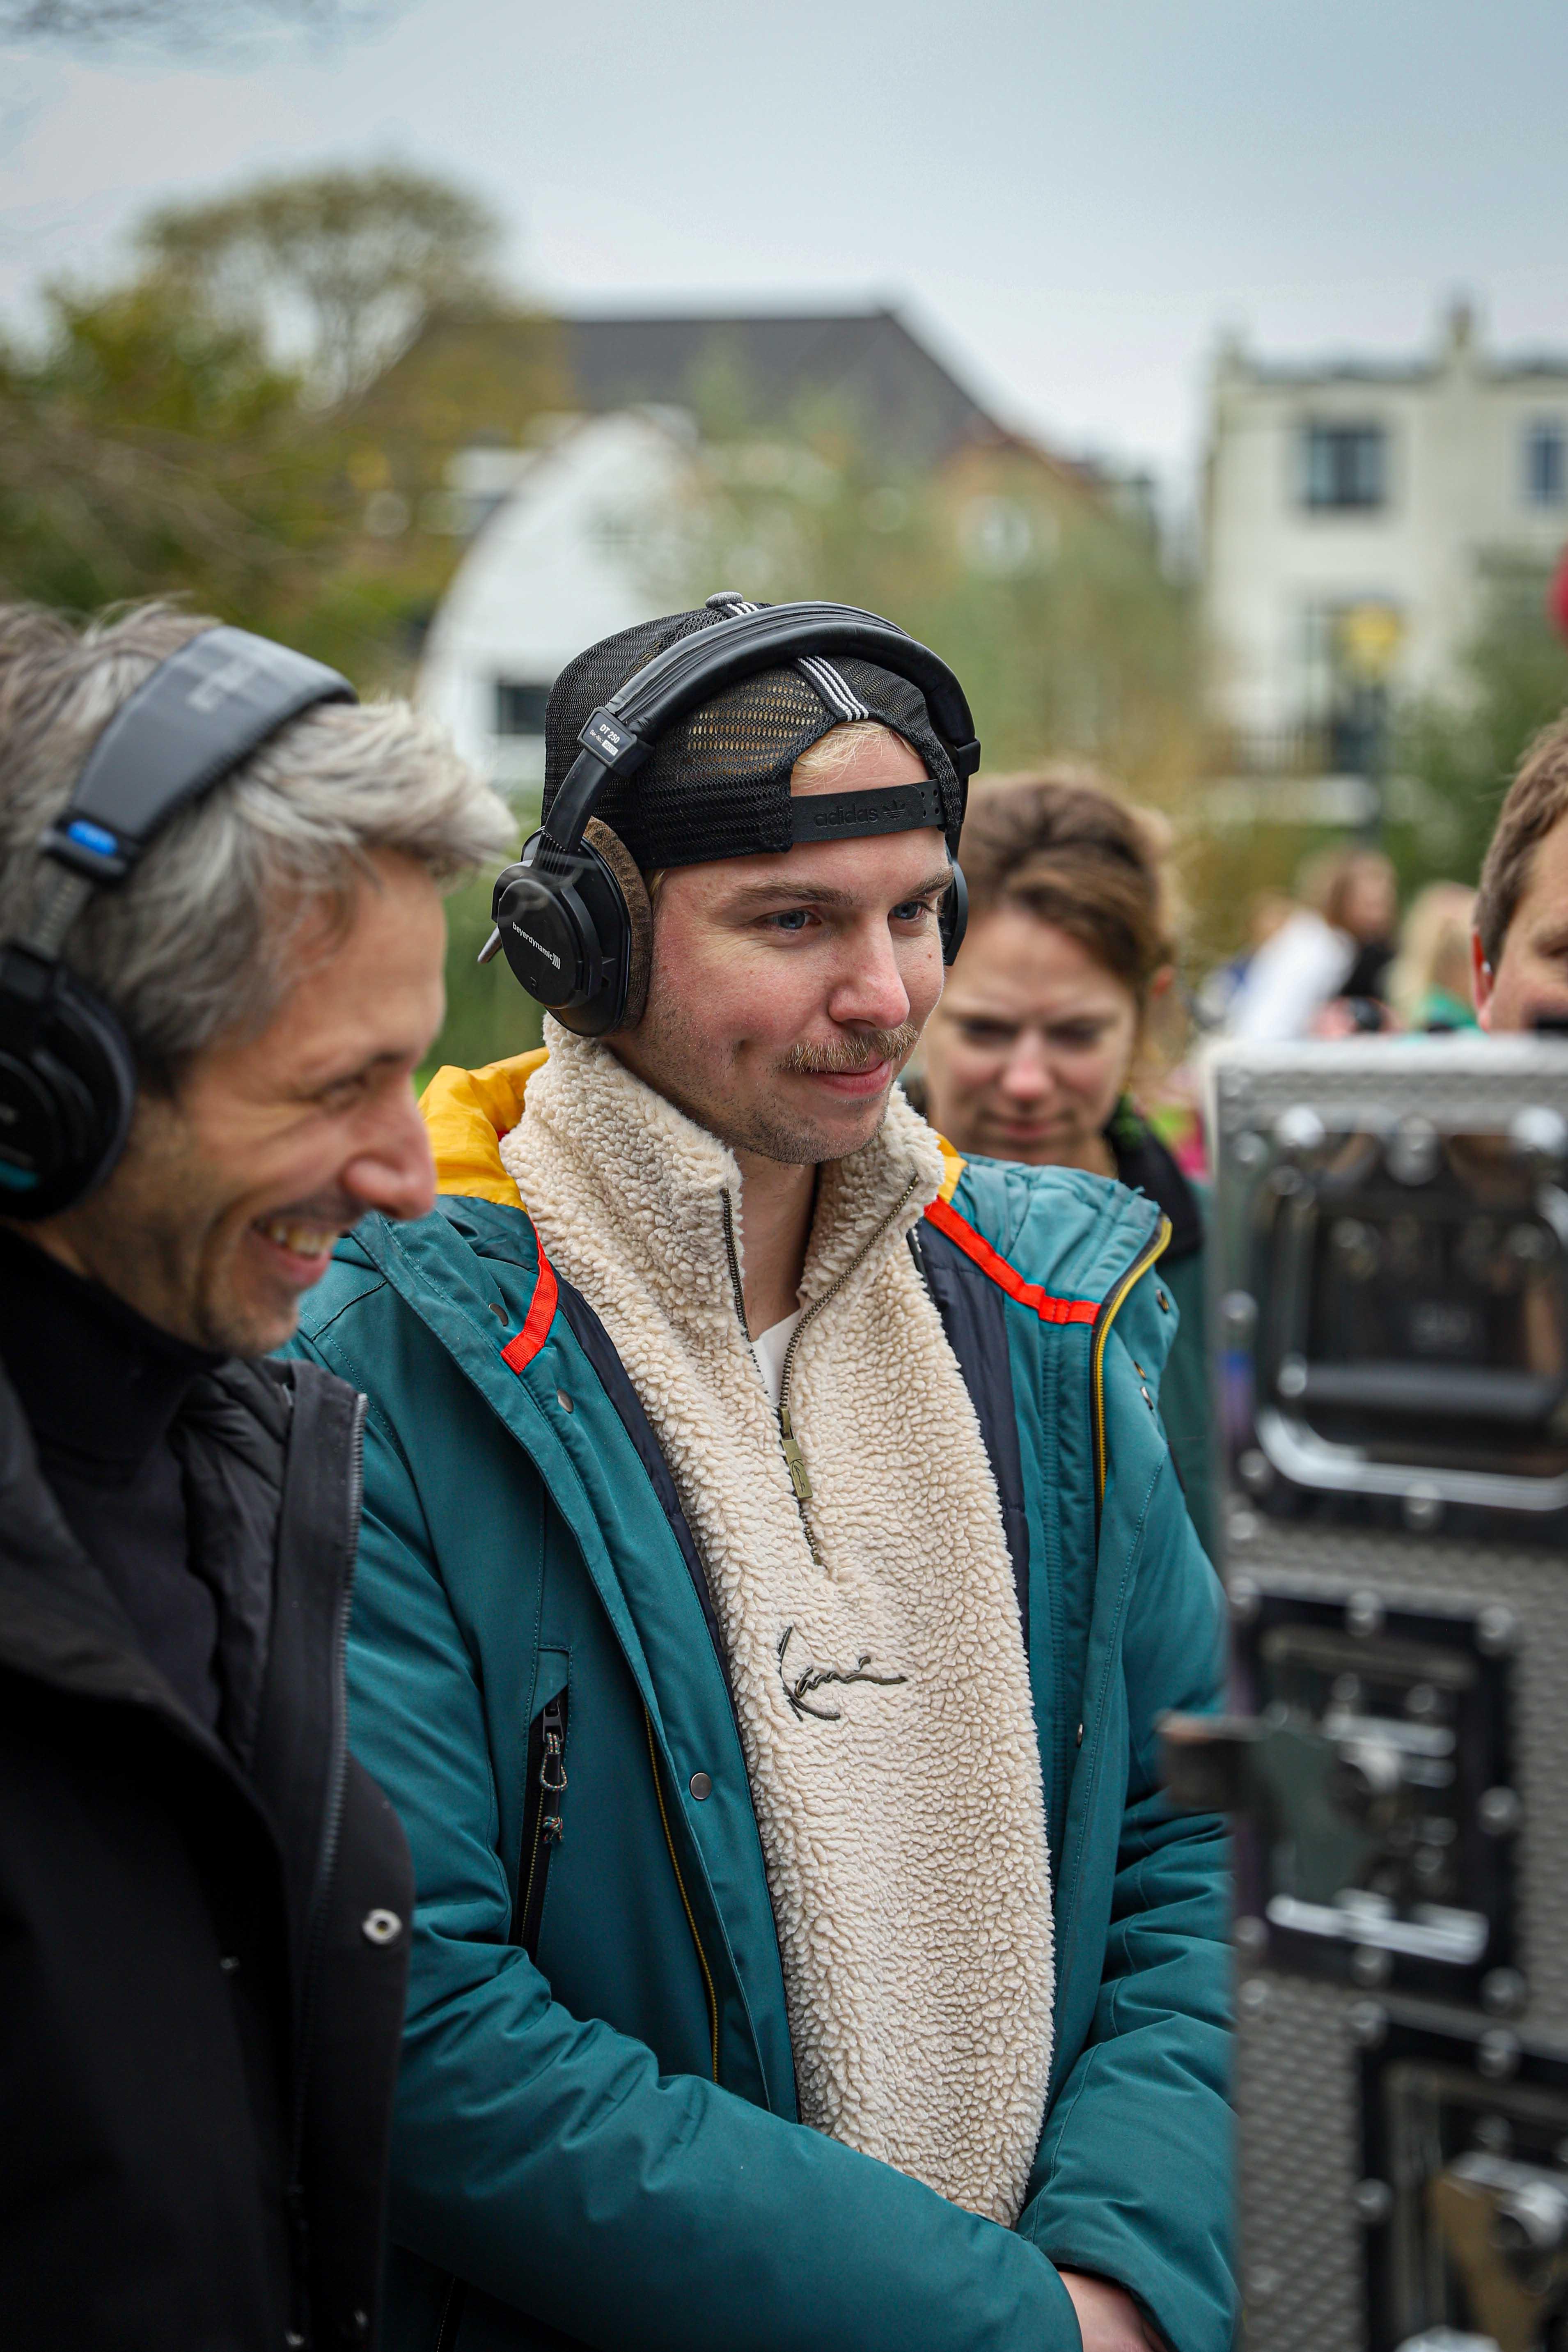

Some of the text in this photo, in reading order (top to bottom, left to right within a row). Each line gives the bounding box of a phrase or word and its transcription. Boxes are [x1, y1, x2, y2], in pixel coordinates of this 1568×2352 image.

[599, 724, 620, 743] DT 250
[814, 803, 878, 828] adidas
[513, 922, 553, 961] beyerdynamic
